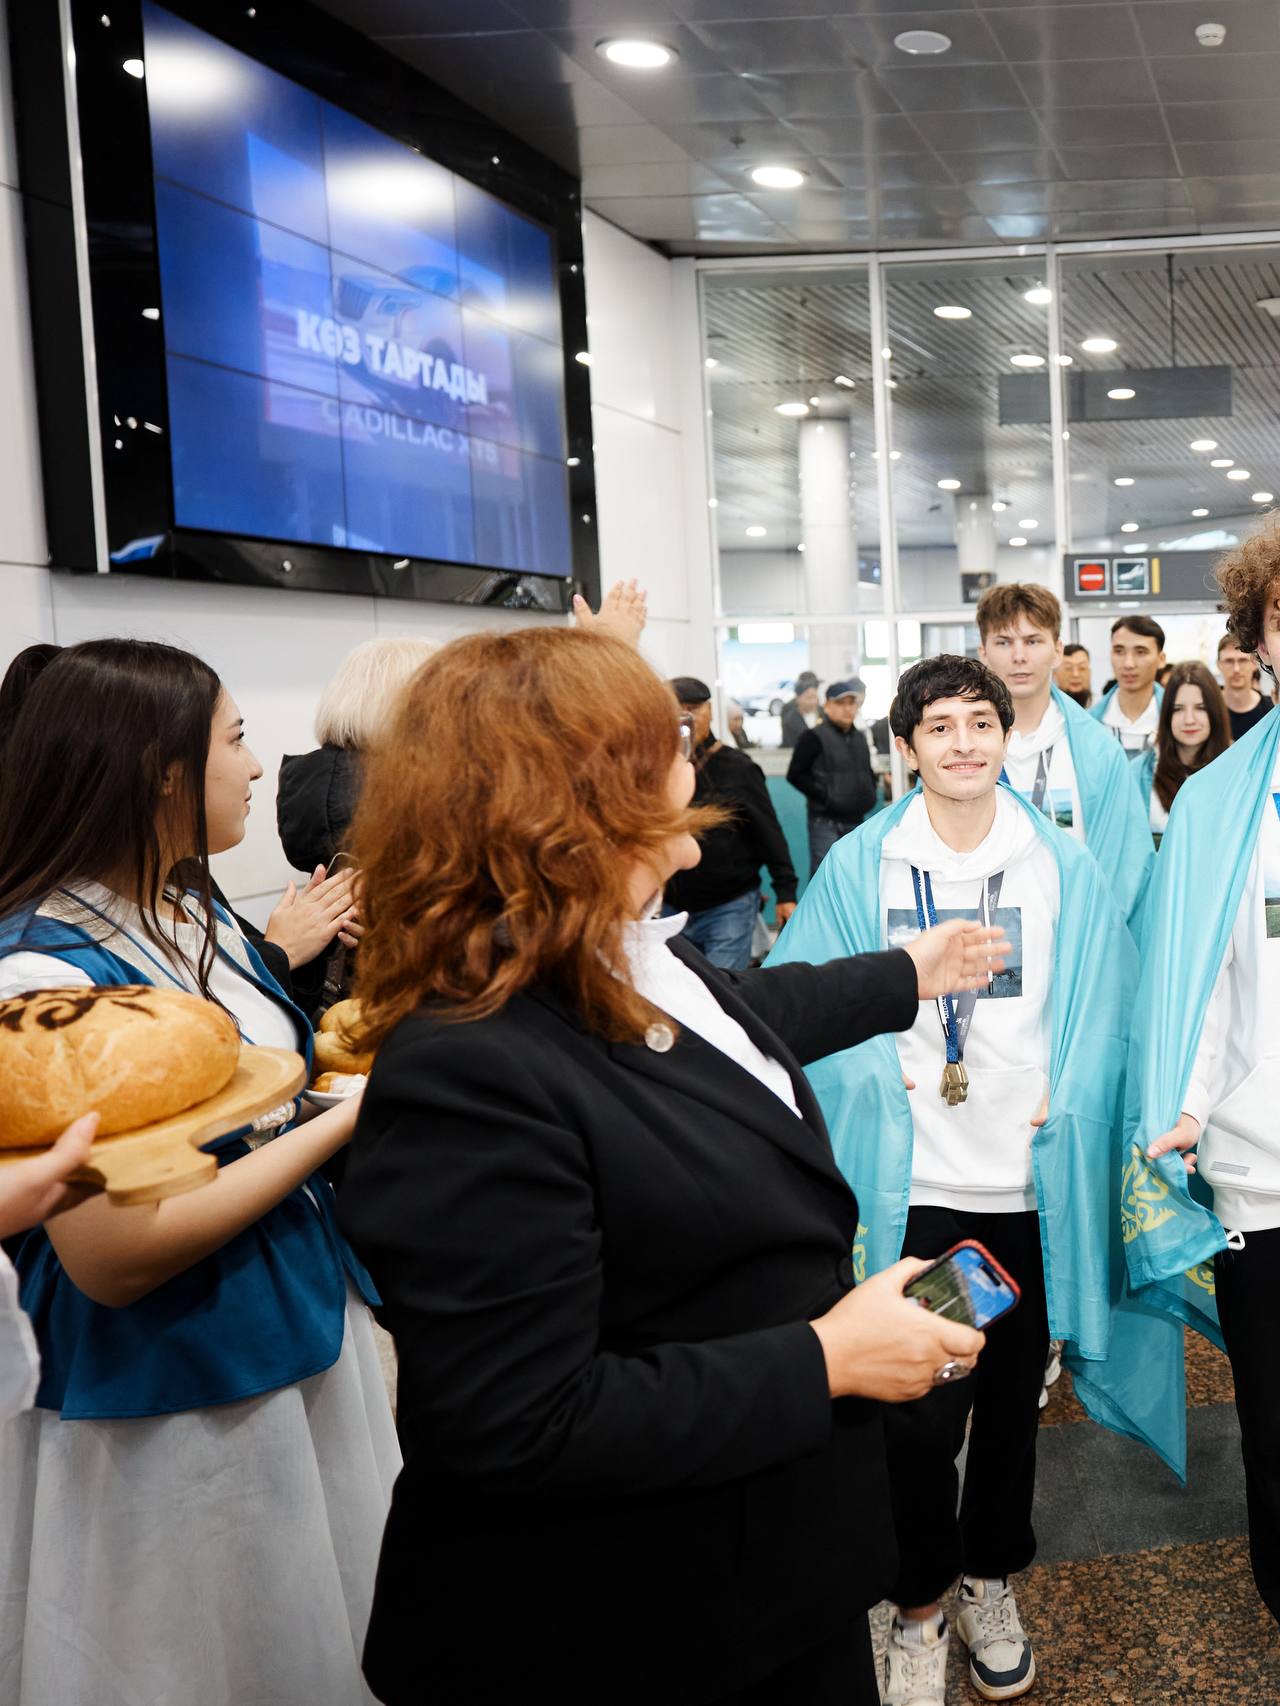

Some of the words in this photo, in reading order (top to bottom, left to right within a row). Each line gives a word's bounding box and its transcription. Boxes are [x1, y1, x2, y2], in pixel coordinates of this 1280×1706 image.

[297, 309, 361, 365] КӨЗ
[365, 332, 488, 405] ТАРТАДЫ
[321, 400, 453, 452] CADILLAC
